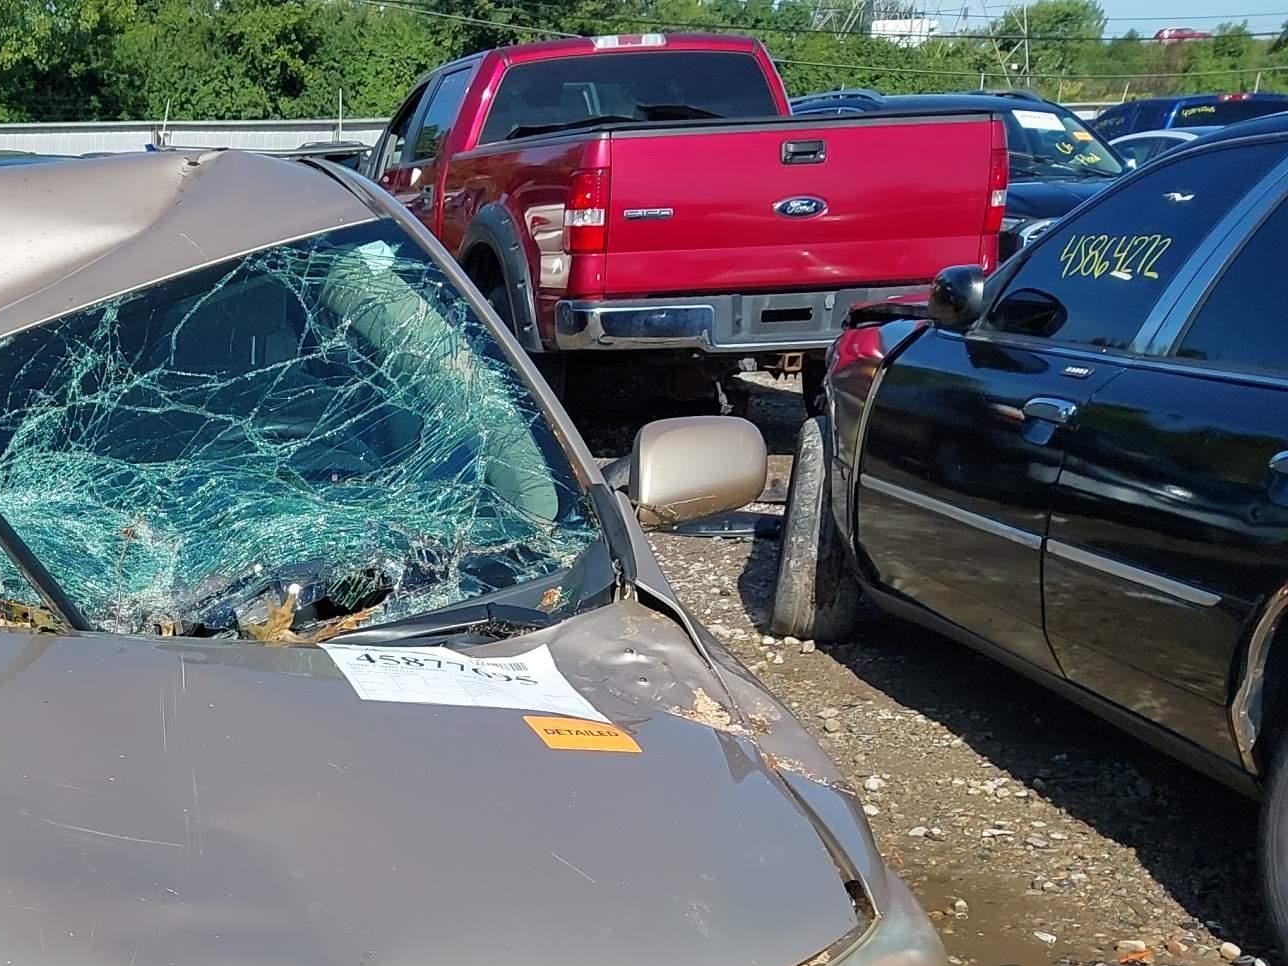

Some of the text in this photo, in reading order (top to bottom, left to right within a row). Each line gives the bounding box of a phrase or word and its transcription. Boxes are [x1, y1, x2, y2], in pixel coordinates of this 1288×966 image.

[787, 199, 816, 214] Ford
[1060, 234, 1172, 279] 45864272
[543, 727, 620, 738] DETAILED
